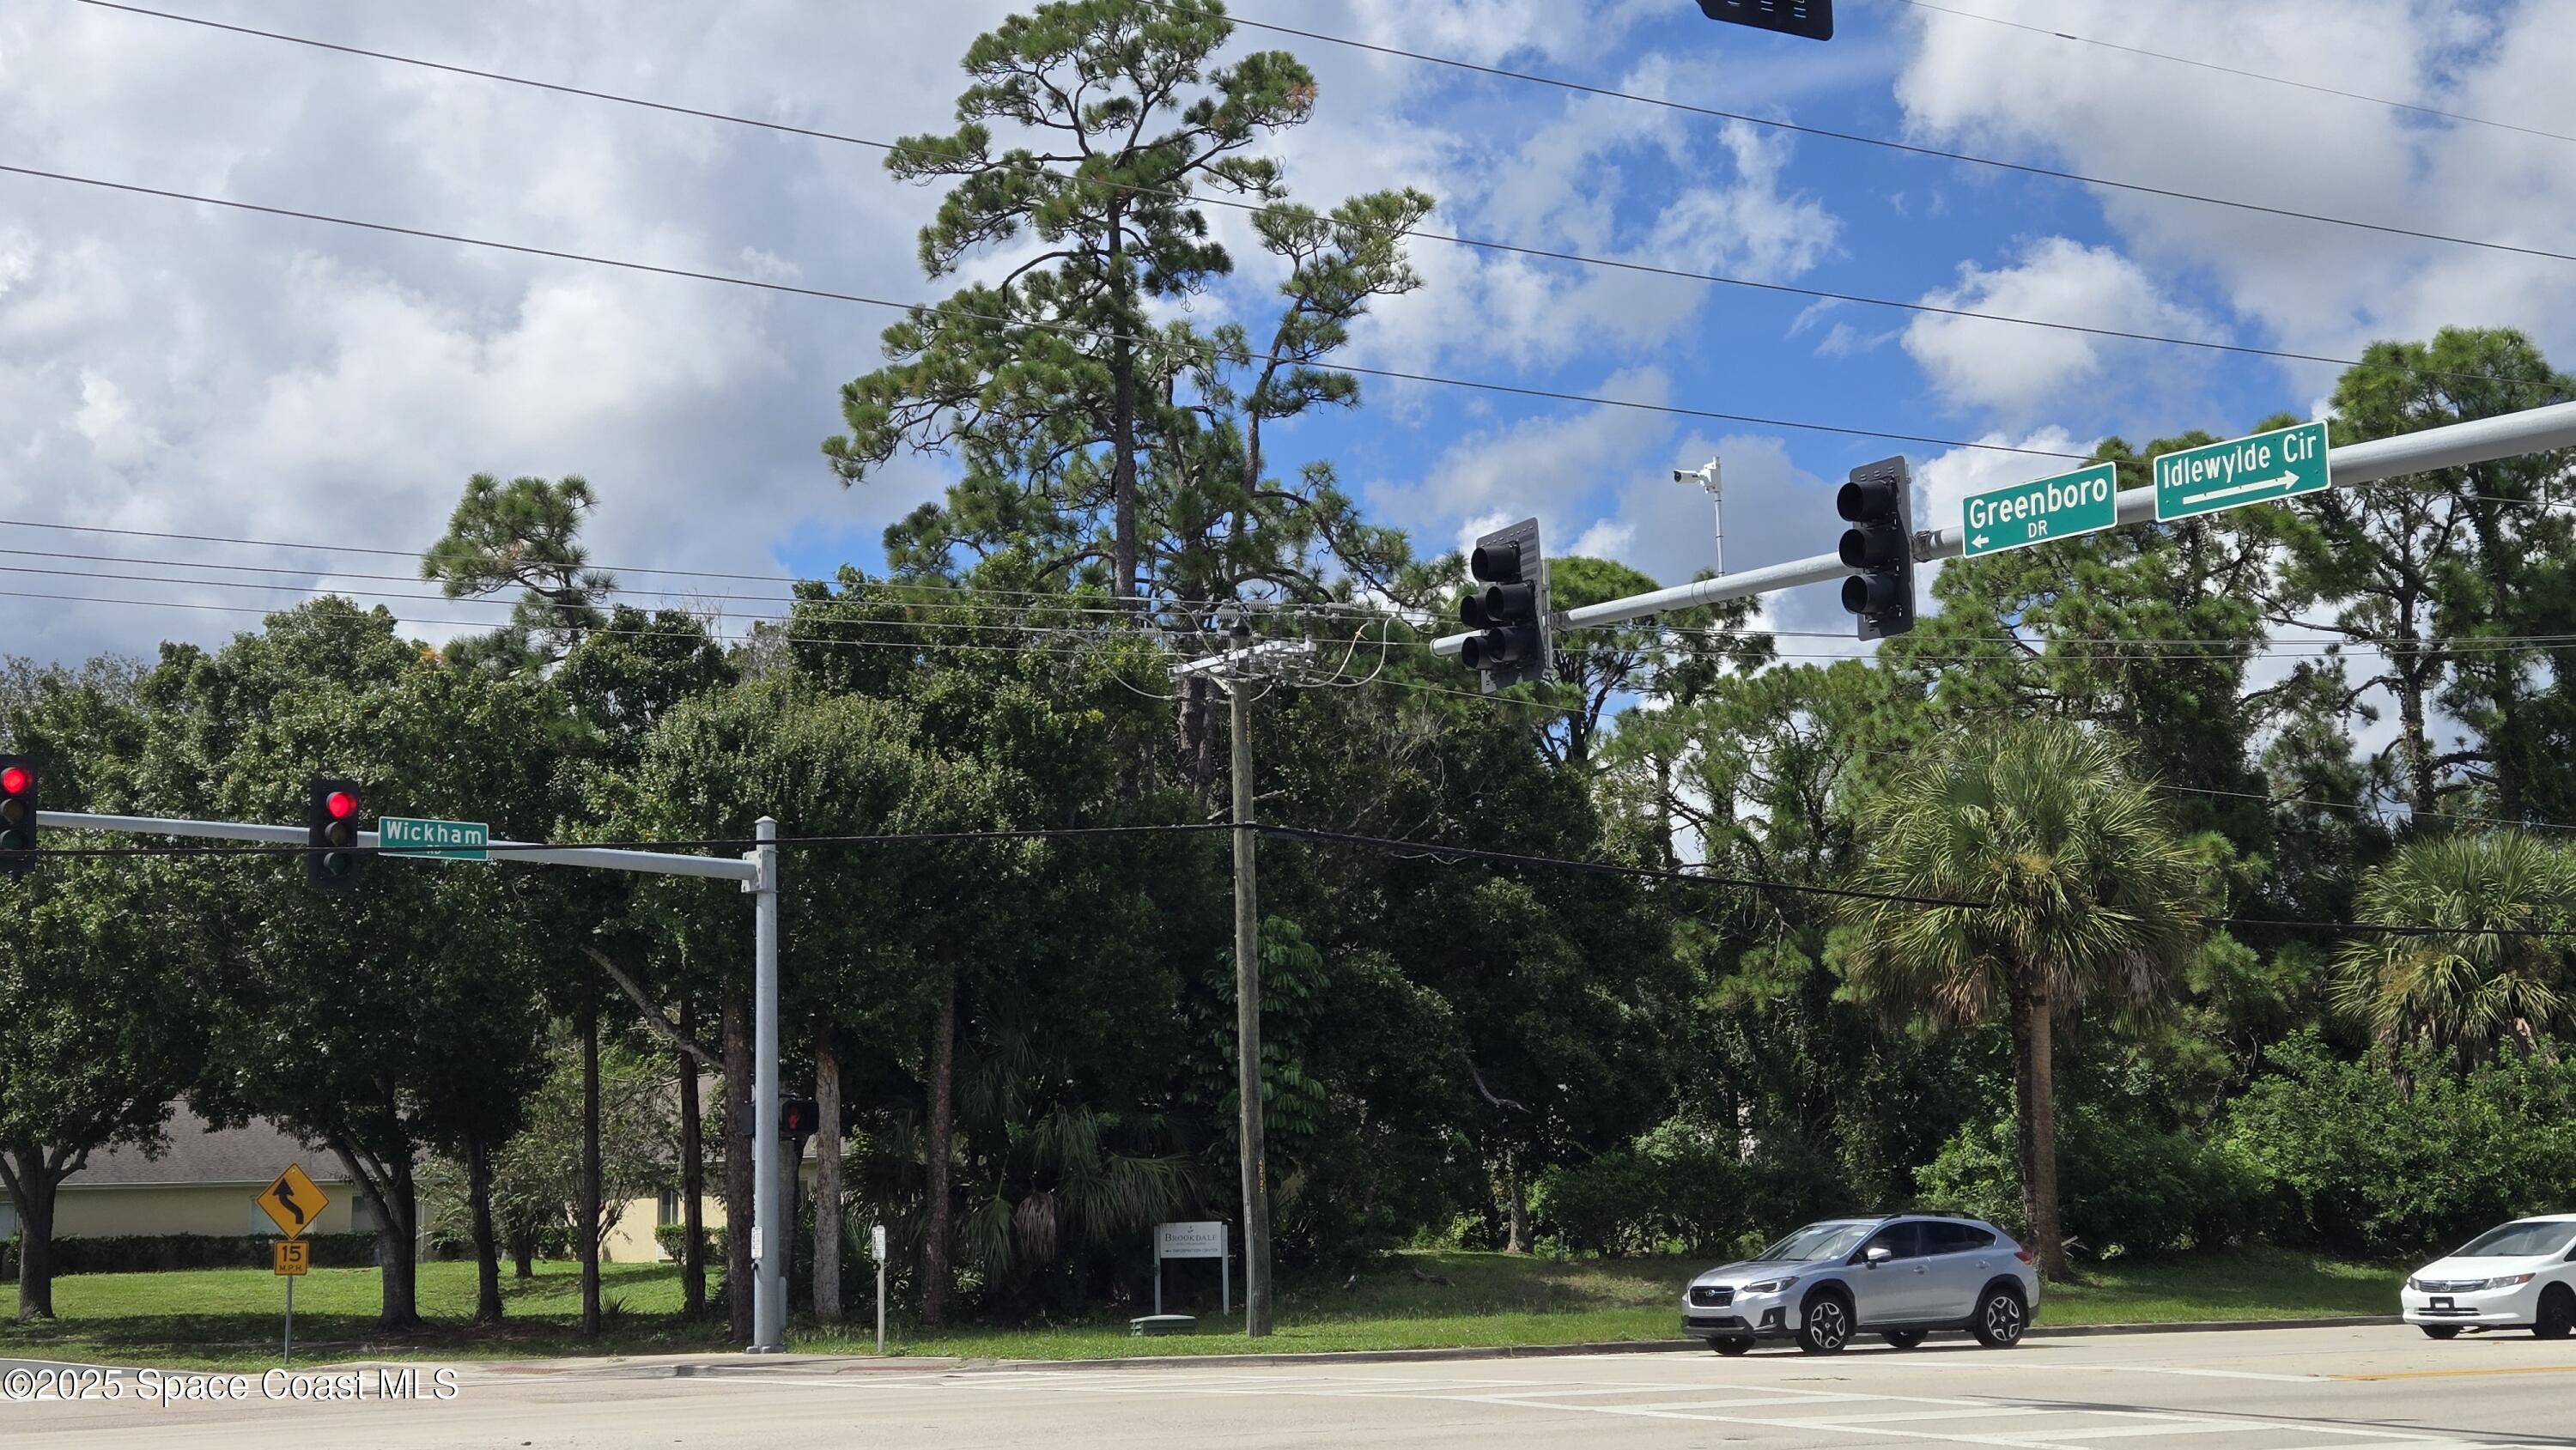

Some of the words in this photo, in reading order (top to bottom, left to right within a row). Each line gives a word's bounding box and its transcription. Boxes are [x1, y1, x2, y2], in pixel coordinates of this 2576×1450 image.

[2163, 445, 2270, 489] Idlewylde
[2283, 433, 2318, 464] Cir
[1969, 477, 2108, 530] Greenboro
[2027, 519, 2048, 539] DR
[386, 820, 482, 845] Wickham
[282, 1245, 301, 1263] 15
